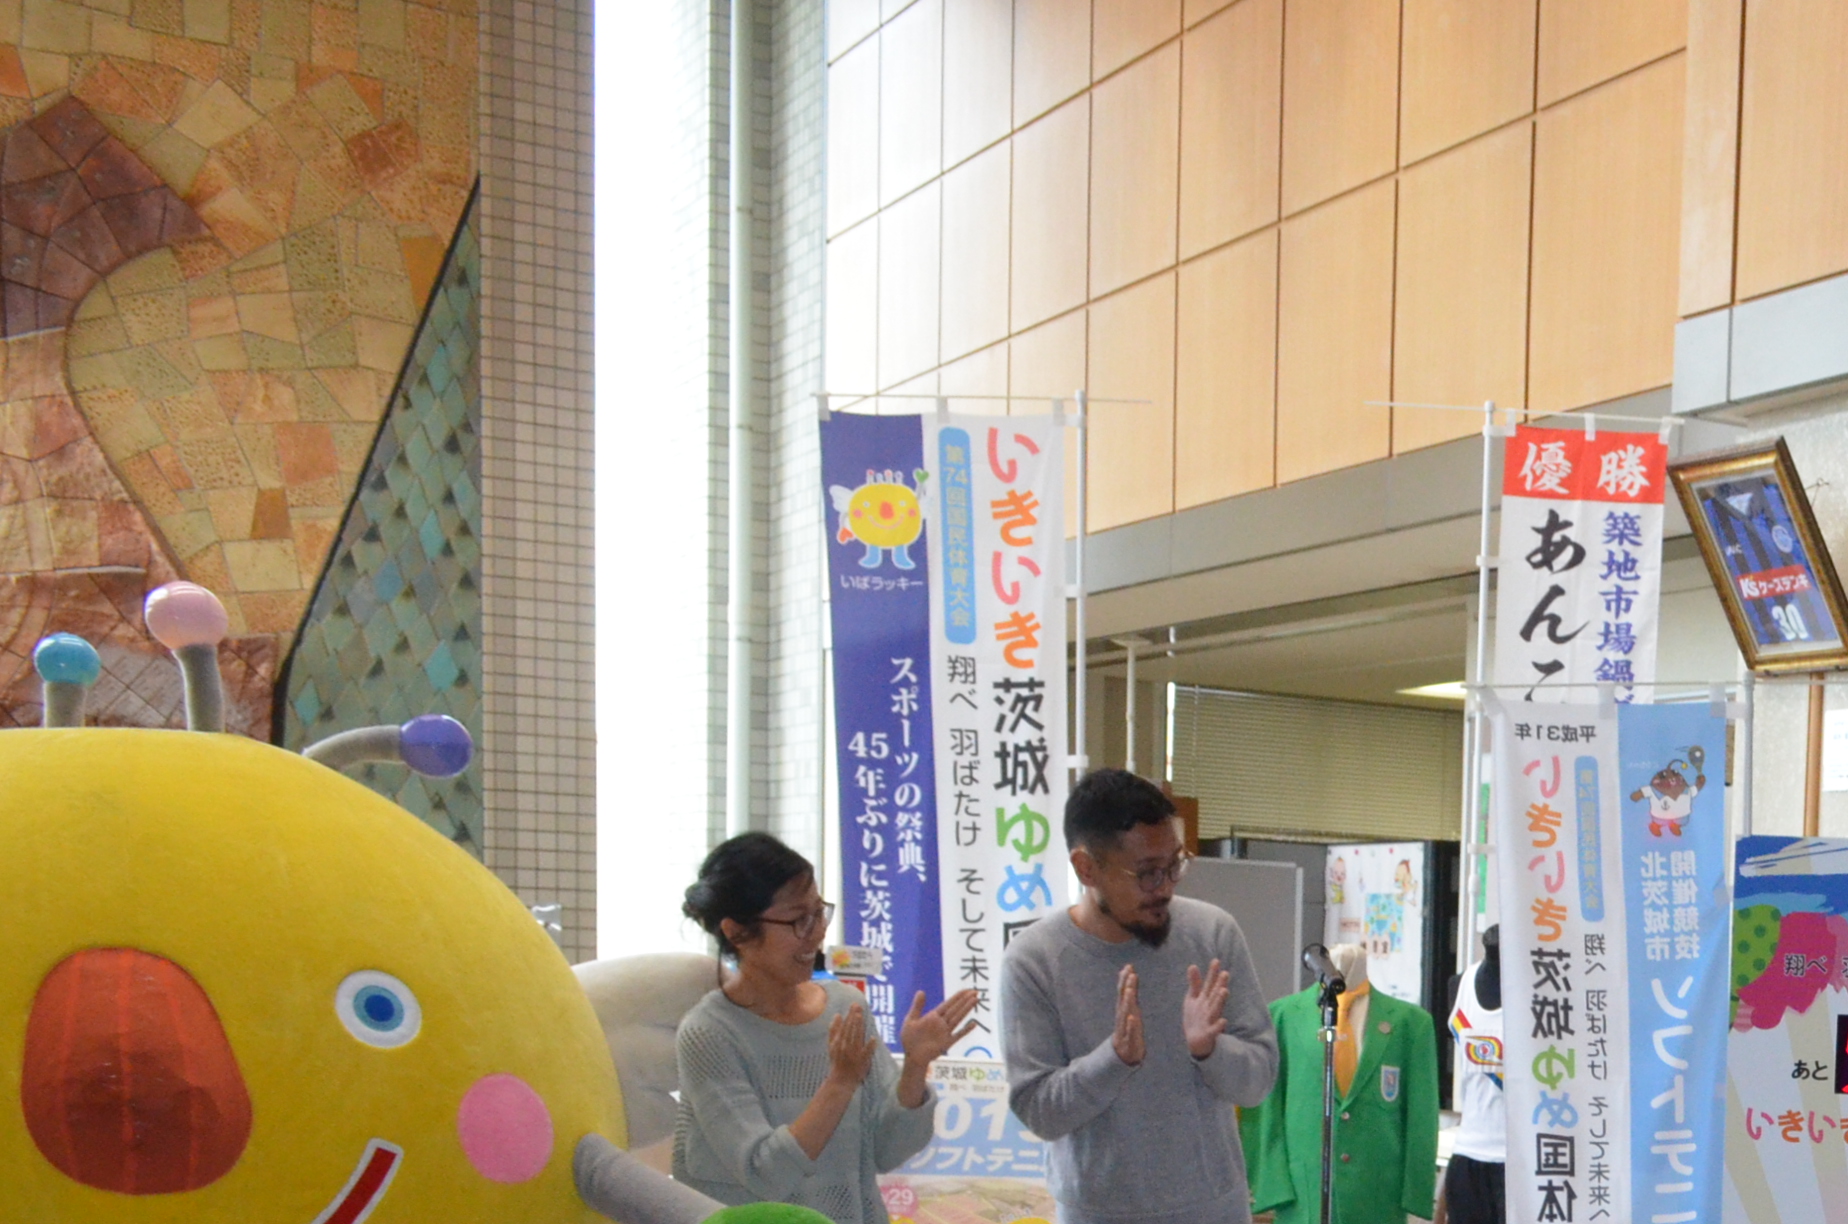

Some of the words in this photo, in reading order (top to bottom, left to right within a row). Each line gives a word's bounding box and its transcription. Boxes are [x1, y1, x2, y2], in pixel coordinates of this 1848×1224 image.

[1518, 440, 1651, 499] 優勝
[841, 573, 924, 591] いばラッキー
[1772, 603, 1809, 641] 30
[946, 655, 978, 711] 翔べ
[890, 656, 927, 882] スポーツの祭典、
[949, 727, 982, 848] 羽ばたけ
[1784, 954, 1828, 976] 翔べ
[926, 1066, 1005, 1082] 茨城ゆめ
[1791, 1059, 1829, 1081] あと
[934, 1097, 1043, 1142] 01
[910, 1146, 1045, 1172] ソフトテニ
